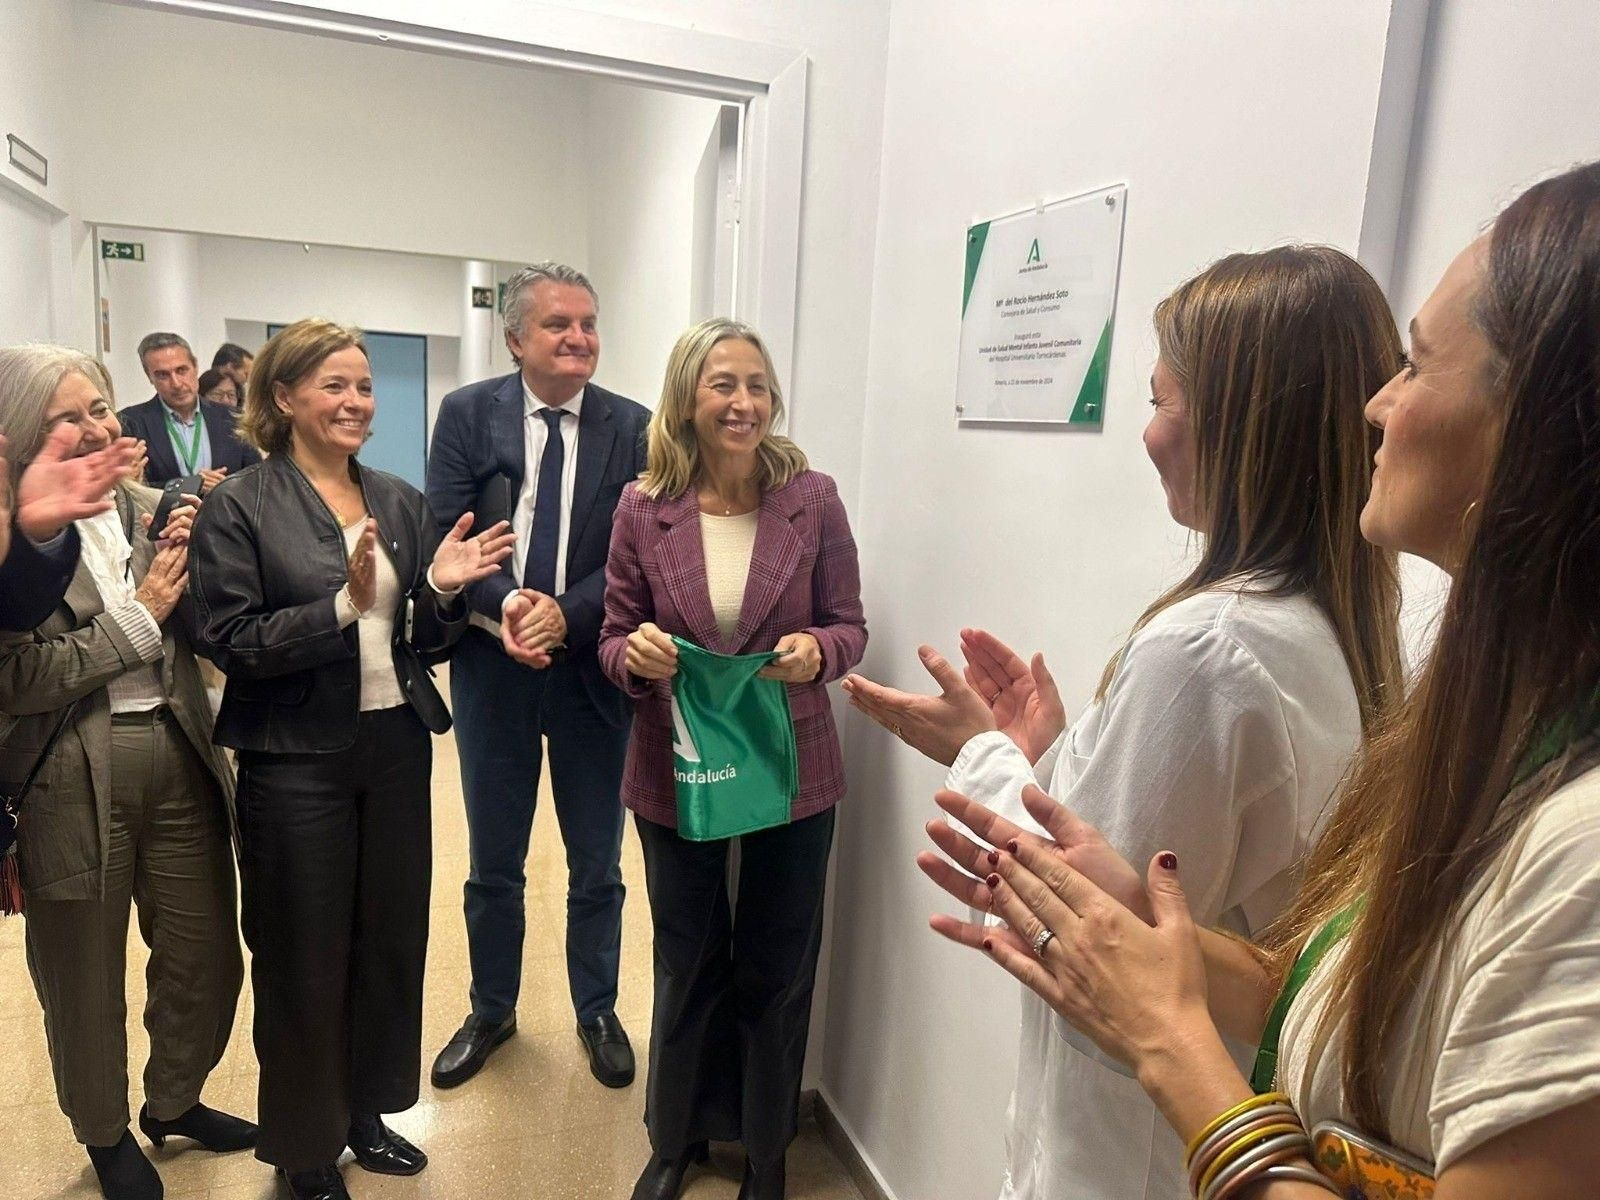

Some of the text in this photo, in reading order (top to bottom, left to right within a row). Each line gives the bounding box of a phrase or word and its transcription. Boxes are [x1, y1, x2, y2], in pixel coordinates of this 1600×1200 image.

[1005, 297, 1013, 306] del
[1028, 291, 1055, 303] Hernández
[1056, 290, 1069, 299] Soto
[1041, 304, 1060, 313] Consumo
[979, 346, 991, 354] Unidad
[998, 344, 1008, 352] Salud
[1009, 343, 1022, 351] Mental
[1023, 342, 1038, 350] Infanto
[1039, 340, 1053, 348] Juvenil
[1054, 338, 1081, 347] Comunitaria
[995, 354, 1010, 362] Hospital
[1011, 353, 1035, 361] Universitario
